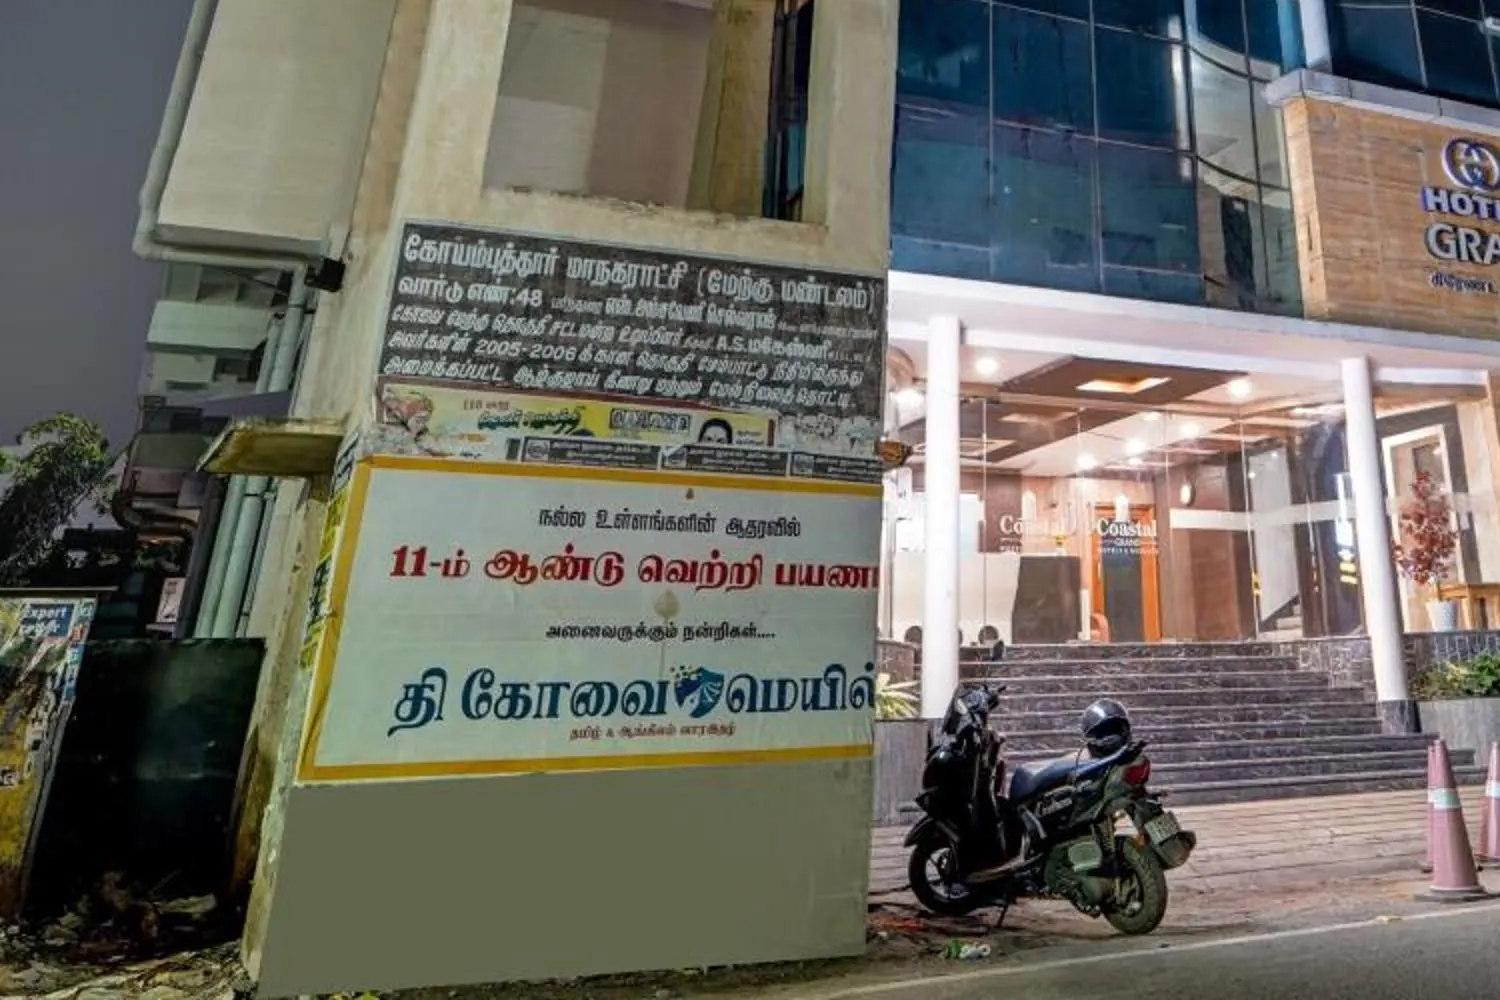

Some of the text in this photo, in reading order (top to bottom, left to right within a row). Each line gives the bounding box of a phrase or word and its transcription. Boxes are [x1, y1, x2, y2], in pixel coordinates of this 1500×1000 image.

[397, 274, 464, 303] வார்டு
[537, 505, 801, 538] நல்ல உள்ளங்களின் ஆதரவில்
[1098, 518, 1157, 537] Coastal
[389, 542, 879, 592] 11-ம் ஆண்டு வெற்றி பயண
[545, 619, 679, 641] அனைவருக்கும்
[387, 667, 447, 736] தி
[461, 667, 672, 721] கோவை
